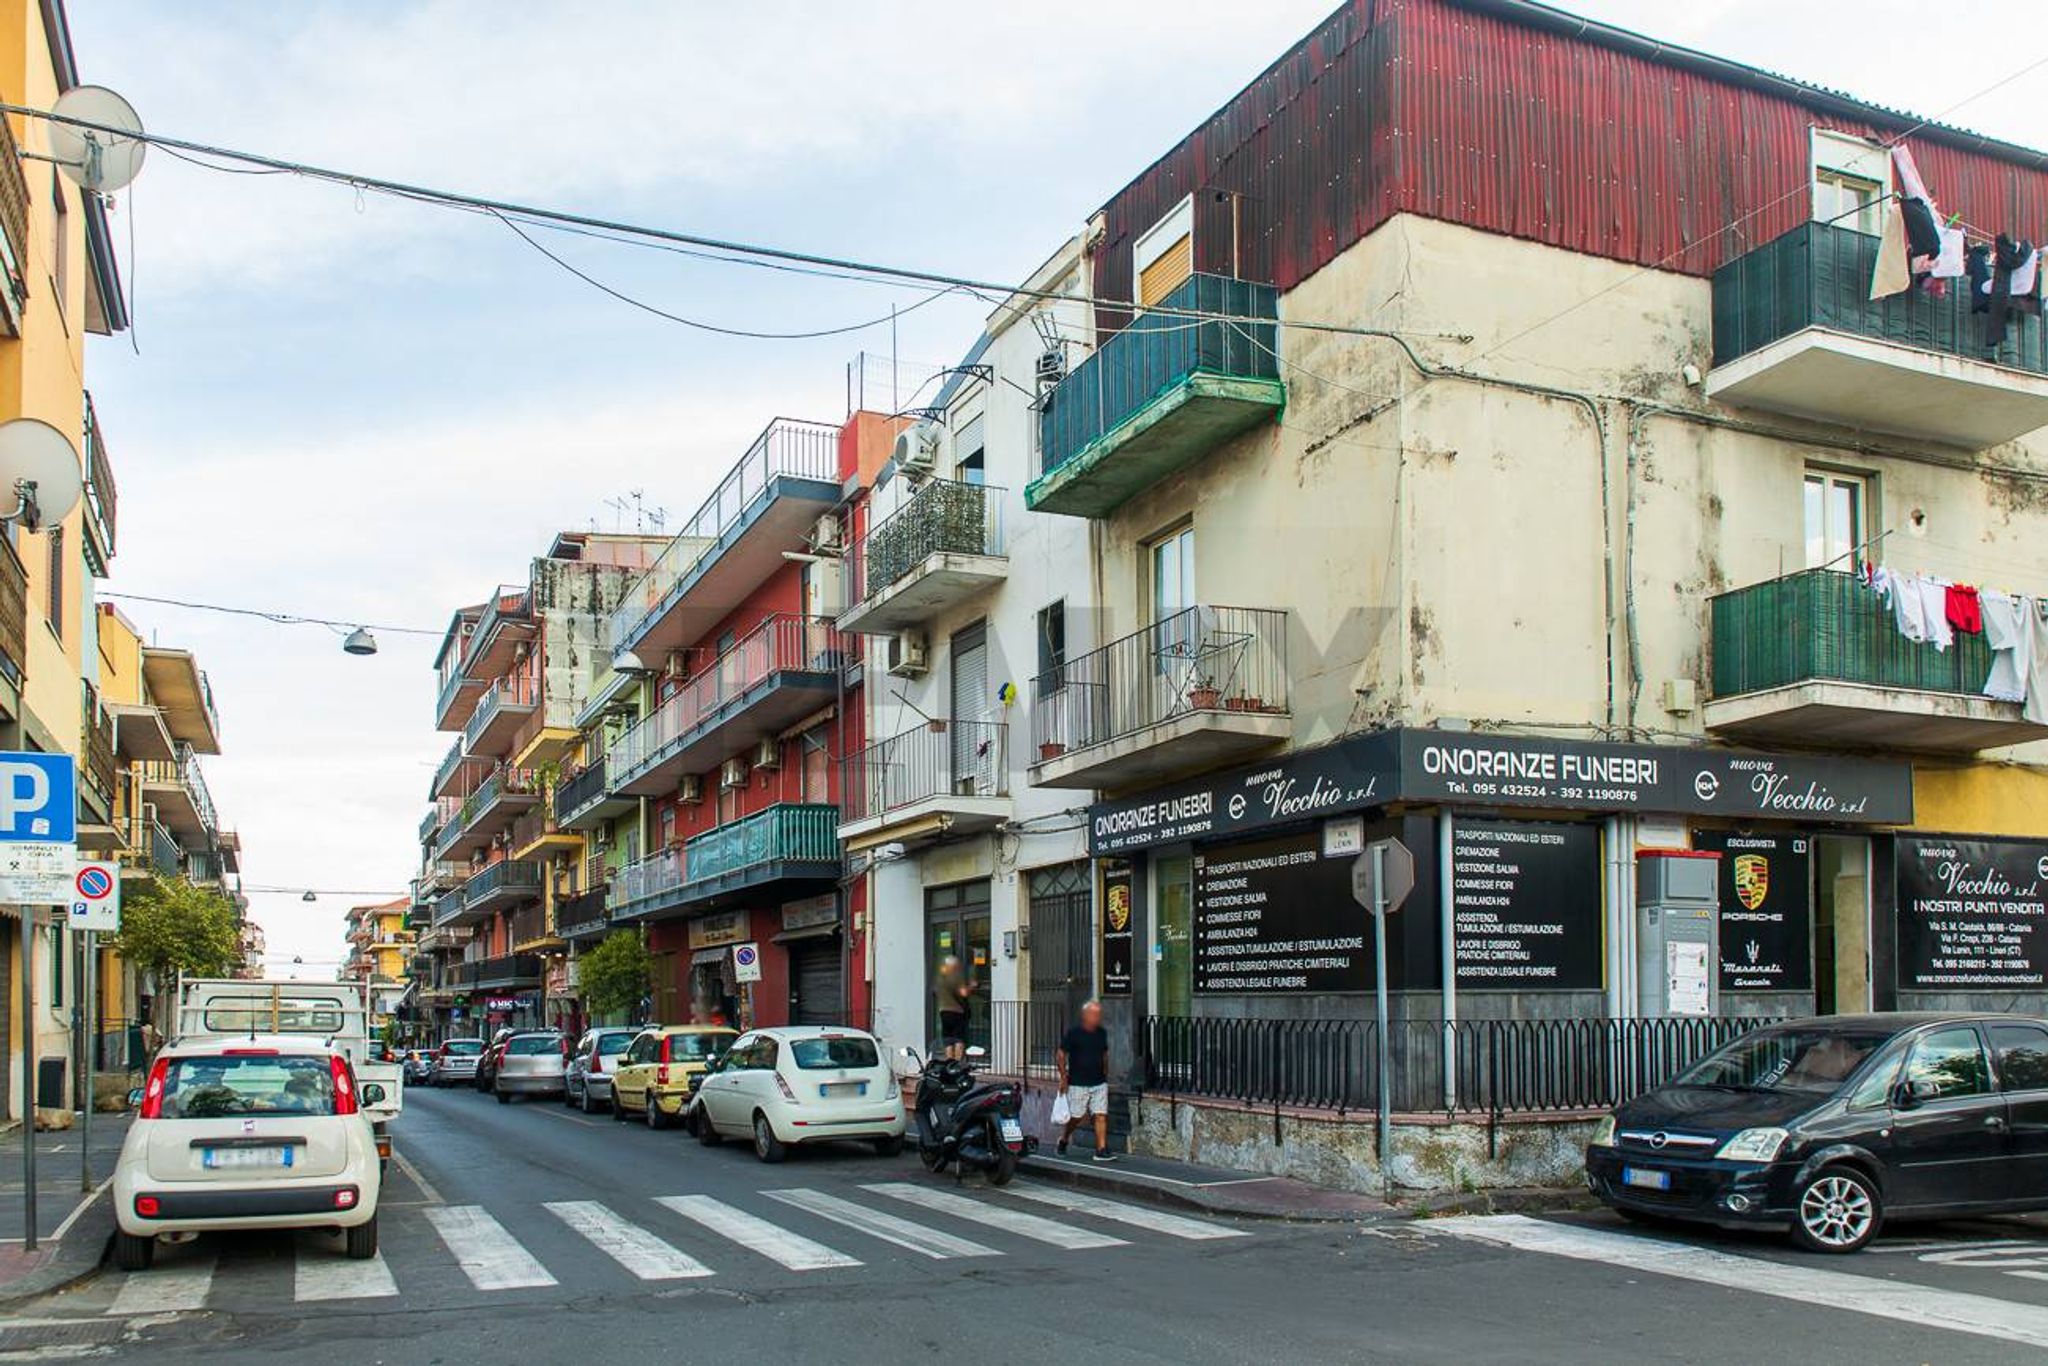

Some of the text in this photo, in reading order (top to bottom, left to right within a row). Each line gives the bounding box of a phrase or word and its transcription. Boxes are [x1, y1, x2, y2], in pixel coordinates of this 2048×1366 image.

[1423, 747, 1658, 785] ONORANZE FUNEBRI
[1730, 759, 1774, 772] nuova
[1246, 769, 1283, 786] nuova
[0, 762, 48, 831] P
[1263, 776, 1341, 819] Vecchio
[1447, 782, 1468, 794] Tel.
[1473, 782, 1497, 795] 095
[1501, 784, 1546, 797] 432524
[1561, 787, 1584, 799] 392
[1587, 788, 1638, 801] 1190876
[1752, 772, 1835, 811] Vecchio
[1095, 792, 1212, 837] ONORANZE FUNEBRI
[1110, 838, 1124, 848] 095
[1126, 833, 1152, 845] 432524
[1161, 828, 1175, 839] 392
[1178, 820, 1212, 835] 1190876
[1456, 830, 1564, 845] TRASPORTI NAZIONALI ED ESTERI
[1727, 838, 1776, 848] ESCLUSIVISTA
[1456, 846, 1500, 857] CREMAZIONE
[1207, 861, 1243, 875] TRASPORTI
[1244, 856, 1277, 871] NAZIONALI
[1278, 855, 1289, 866] ED
[1290, 851, 1317, 864] ESTERI
[1456, 863, 1520, 874] VESTIZIONE SALMA
[1206, 878, 1248, 892] CREMAZIONE
[1456, 879, 1514, 890] COMMESSE FIORI
[1938, 861, 2011, 895] Vecchio
[1206, 892, 1267, 908] VESTIZIONE SALMA
[1456, 896, 1510, 906] AMBULANZA H24
[1914, 899, 2045, 914] I NOSTRI PUNTI VENDITA
[1206, 909, 1262, 925] COMMESSE FIORI
[1456, 913, 1499, 923] ASSISTENZA
[1722, 913, 1784, 922] PORSCHE
[1207, 928, 1245, 940] AMBULANZA
[1456, 924, 1504, 934] TUMULAZIONE
[1509, 924, 1564, 935] ESTUMULAZIONE
[1207, 943, 1245, 956] ASSISTENZA
[1245, 941, 1294, 954] TUMULAZIONE
[1299, 937, 1363, 951] ESTUMULAZIONE
[1456, 940, 1521, 950] LAVORI E DISBRIGO
[1456, 950, 1490, 960] PRATICHE
[1207, 961, 1231, 973] LAVORI
[1236, 959, 1268, 972] DISBRIGO
[1269, 958, 1304, 971] PRATICHE
[1457, 967, 1557, 977] ASSISTENZA LEGALE FUNEBRE
[1207, 976, 1307, 988] ASSISTENZA LEGALE FUNEBRE
